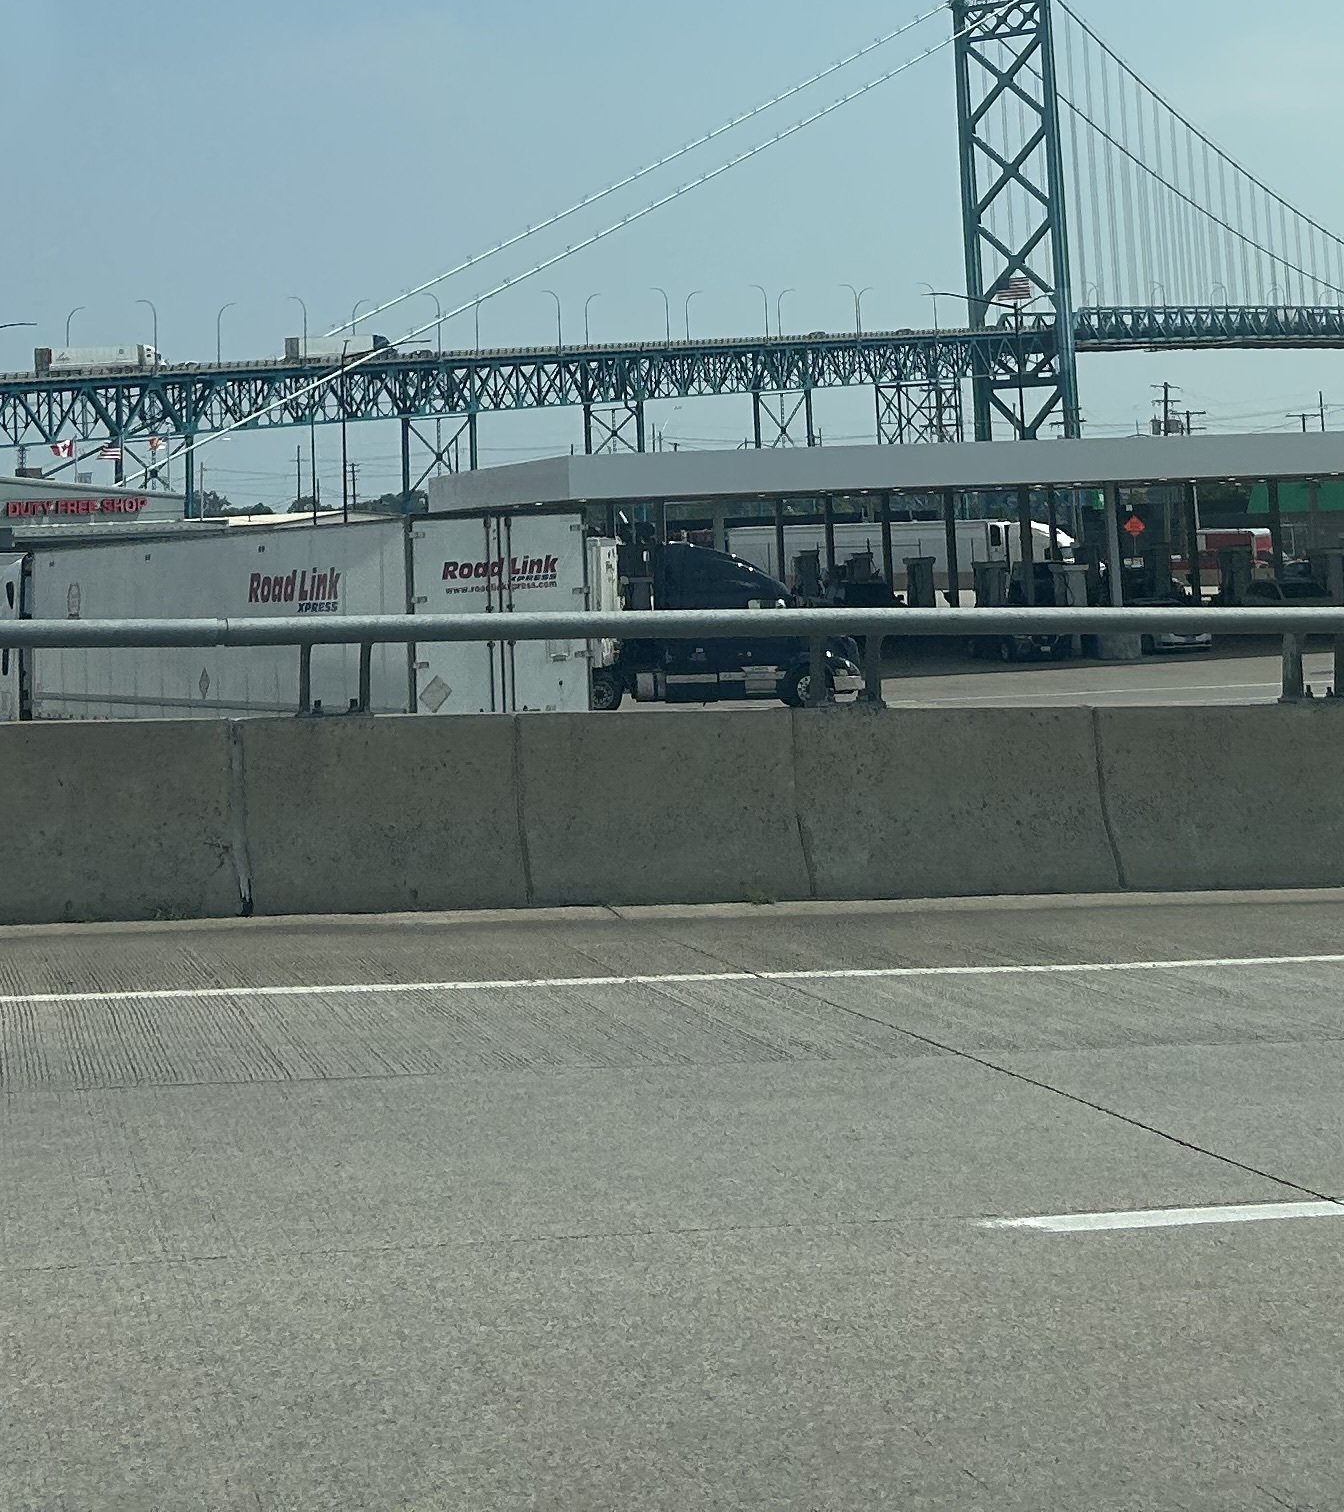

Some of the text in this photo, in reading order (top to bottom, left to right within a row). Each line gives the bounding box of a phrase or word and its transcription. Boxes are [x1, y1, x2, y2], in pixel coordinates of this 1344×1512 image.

[7, 496, 148, 518] DUTY FREE SHOP
[442, 554, 559, 581] Road Link
[248, 567, 342, 603] Road Link
[445, 580, 557, 594] www.roadlikpress.com
[297, 601, 338, 613] XPRESS
